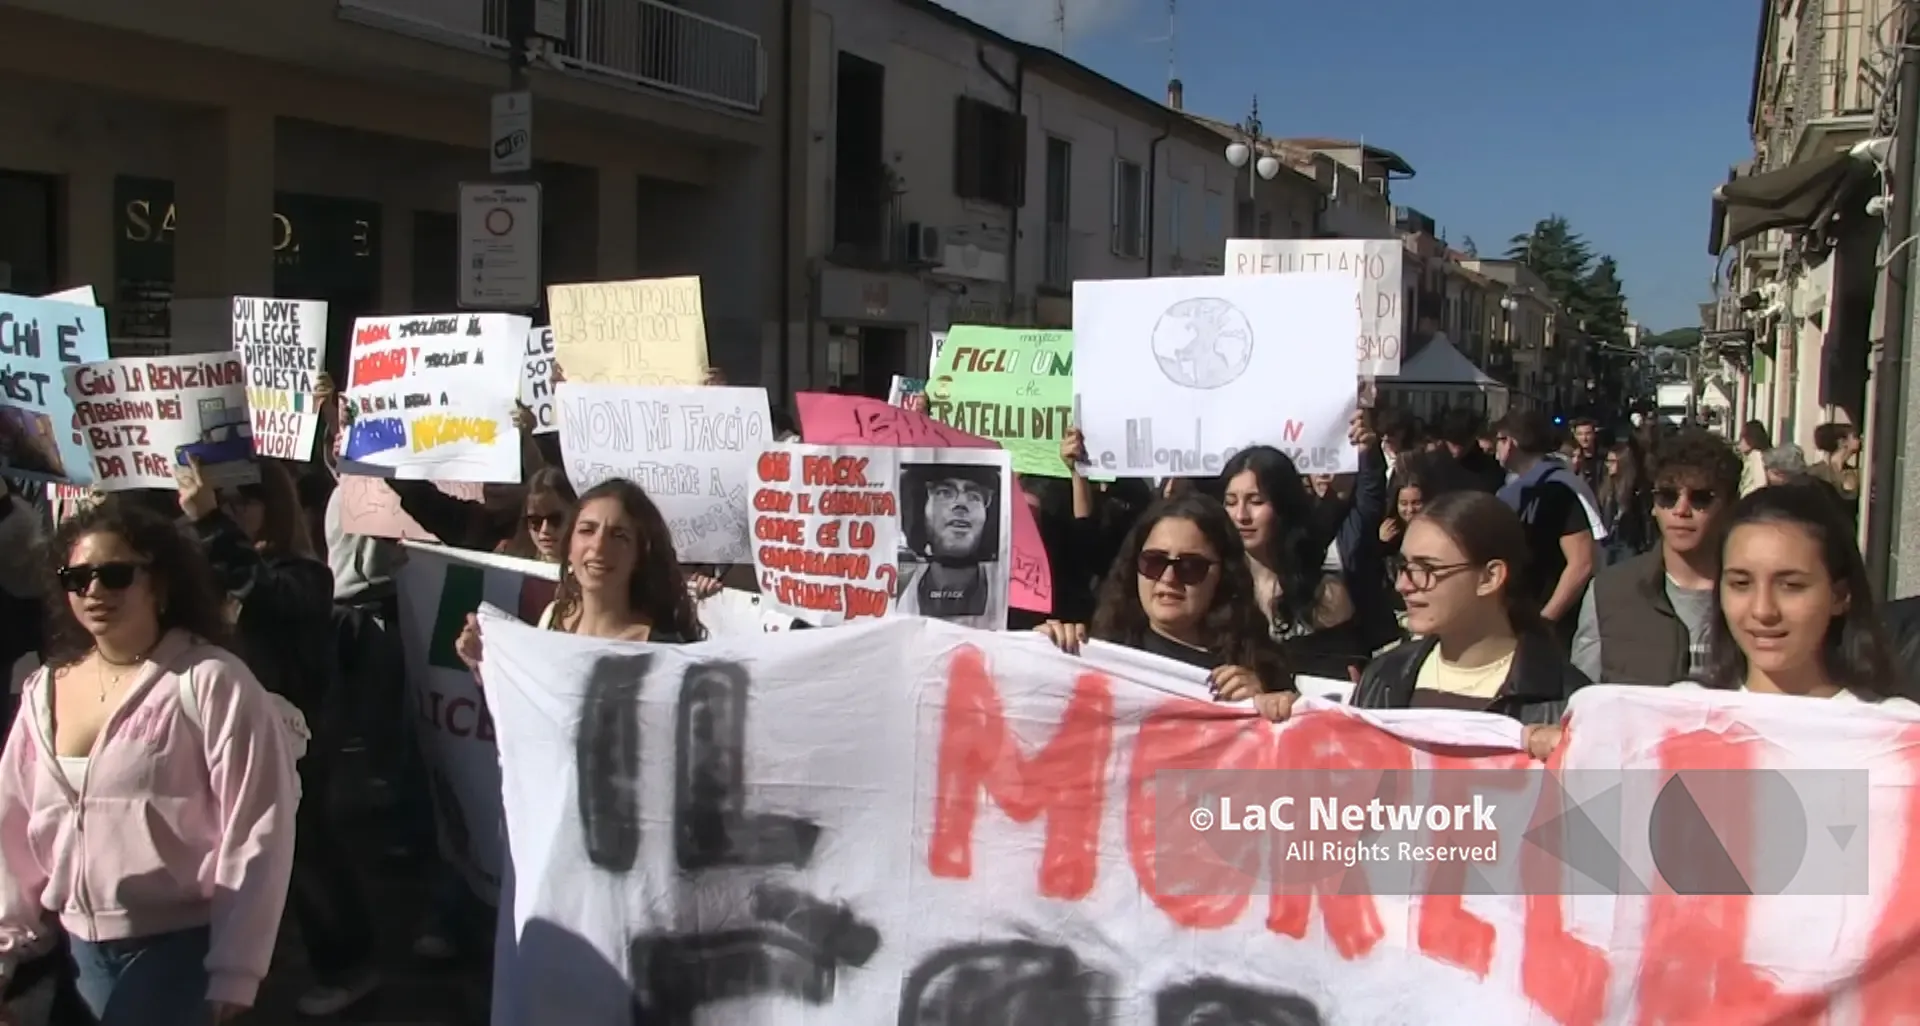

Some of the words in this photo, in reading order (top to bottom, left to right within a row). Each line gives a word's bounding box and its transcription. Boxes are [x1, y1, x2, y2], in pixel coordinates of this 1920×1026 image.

[264, 301, 300, 324] DOVE
[1377, 292, 1396, 318] DI
[252, 323, 301, 346] LEGGE
[952, 347, 1020, 374] FIGLI
[121, 365, 145, 393] LA
[1016, 380, 1043, 397] che
[256, 412, 303, 437] NASCI
[564, 398, 634, 453] NON
[254, 435, 299, 462] MUORI
[98, 452, 128, 480] DA
[134, 451, 174, 479] FARE
[757, 451, 792, 482] OH
[753, 488, 793, 513] CON
[755, 516, 806, 545] COME
[848, 520, 876, 549] LO
[577, 653, 820, 873] IL
